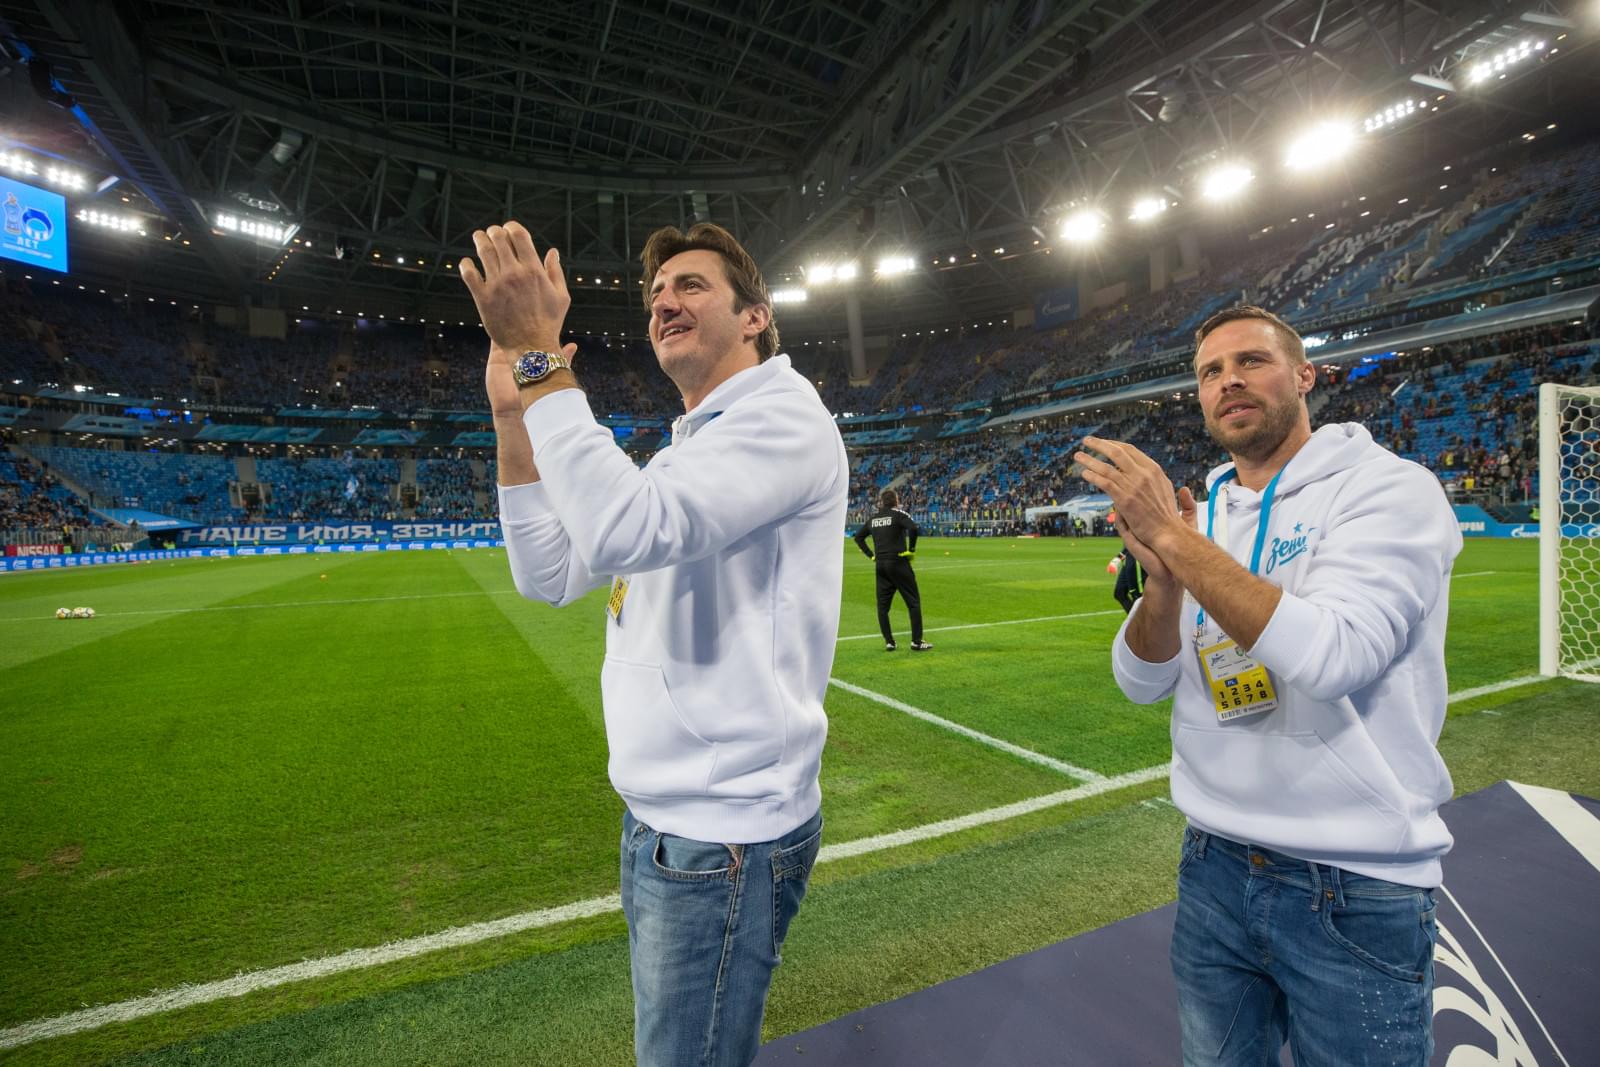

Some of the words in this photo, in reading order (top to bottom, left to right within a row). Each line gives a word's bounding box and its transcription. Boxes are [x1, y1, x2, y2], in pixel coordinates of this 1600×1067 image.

[182, 526, 287, 542] НАШЕ
[392, 523, 498, 538] ЗЕНИТ
[17, 545, 58, 557] NISSAN
[1219, 691, 1225, 699] 1
[1231, 687, 1239, 696] 2
[1243, 684, 1251, 692] 3
[1256, 680, 1263, 688] 4
[1221, 701, 1229, 709] 5
[1234, 697, 1241, 706] 6
[1247, 694, 1253, 702] 7
[1259, 690, 1267, 699] 8
